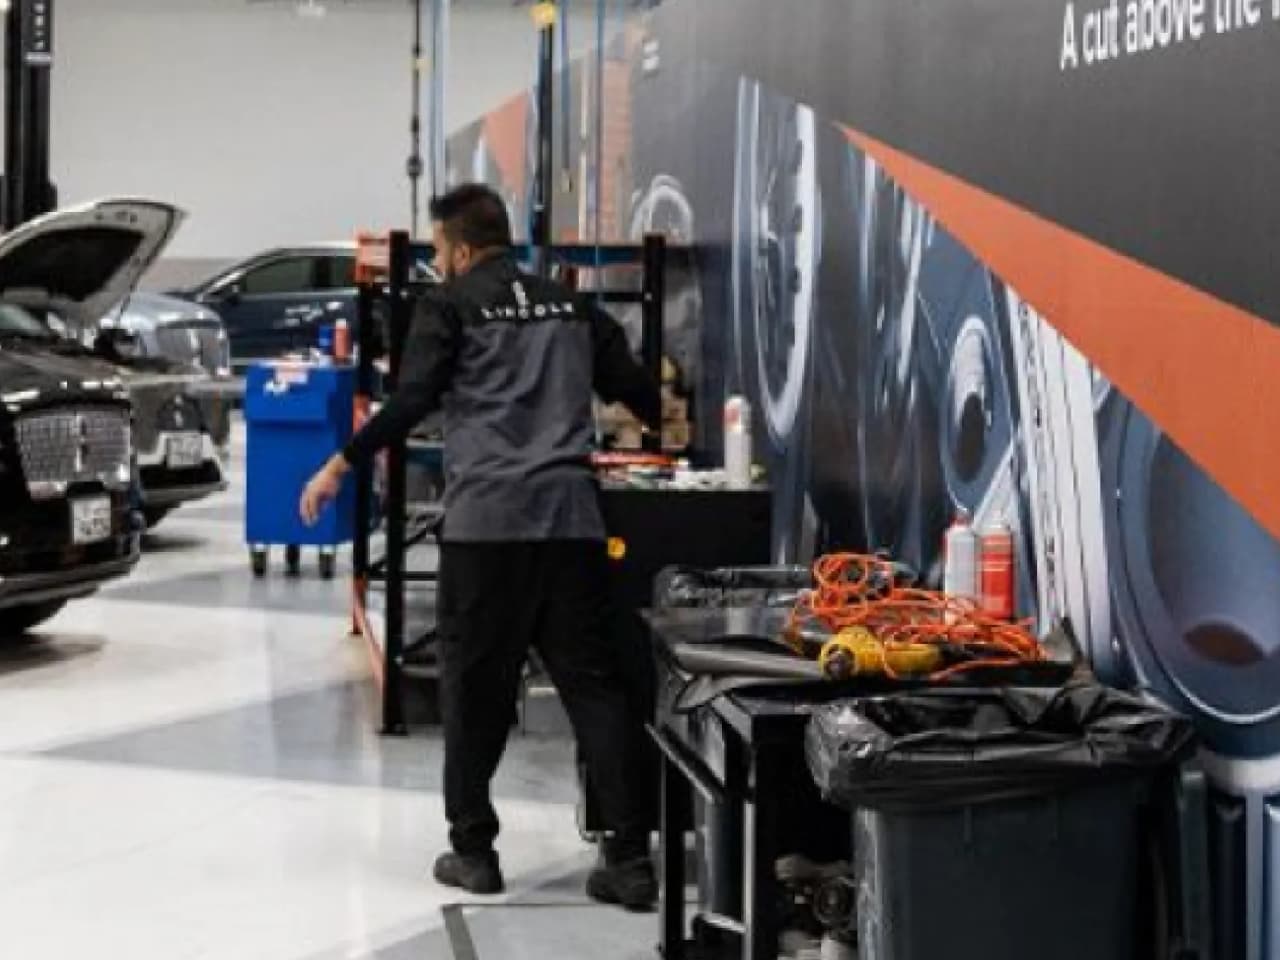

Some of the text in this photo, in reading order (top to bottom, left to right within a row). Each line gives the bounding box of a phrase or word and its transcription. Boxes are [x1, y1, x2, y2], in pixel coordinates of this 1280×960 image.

[1059, 2, 1078, 71] A
[1082, 0, 1118, 65] cut
[1126, 0, 1205, 53] above
